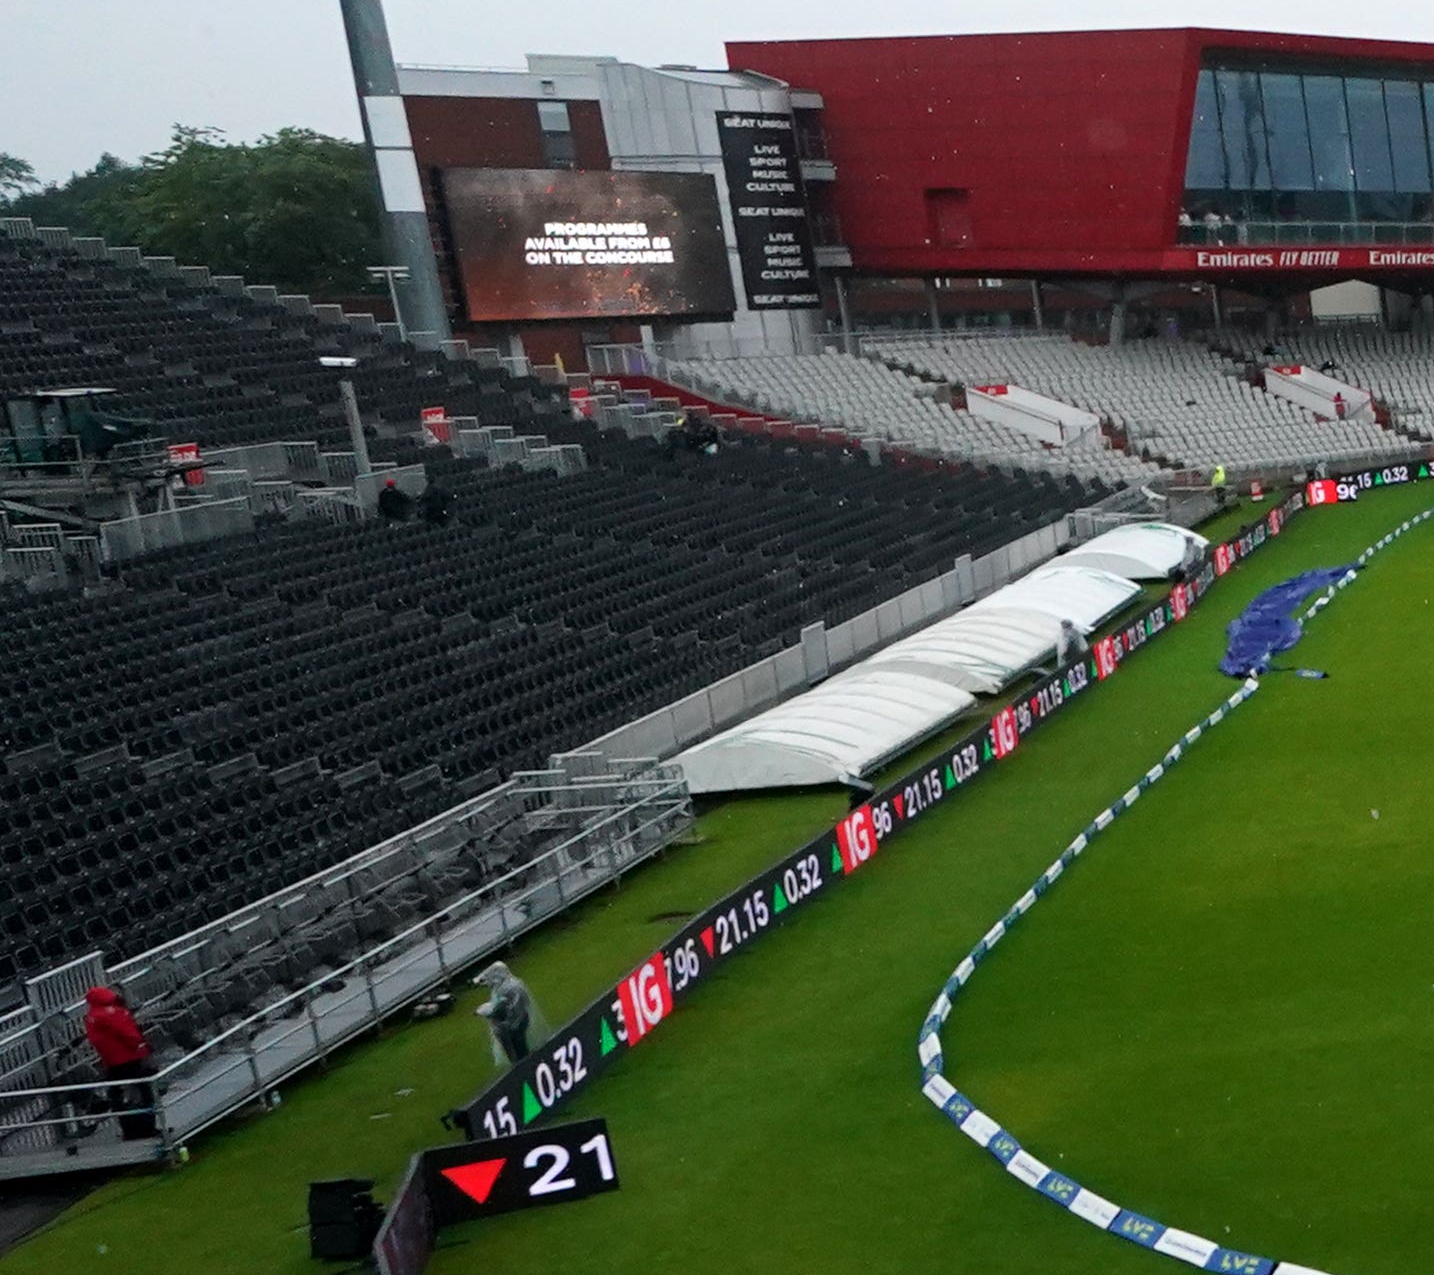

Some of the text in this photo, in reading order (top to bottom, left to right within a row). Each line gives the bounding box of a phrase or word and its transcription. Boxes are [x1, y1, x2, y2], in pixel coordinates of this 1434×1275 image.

[754, 145, 780, 154] LIVE
[544, 223, 647, 235] PROGRAMMES
[768, 233, 794, 242] LIVE
[525, 237, 606, 250] AVAILABLE
[608, 237, 650, 249] FROM
[525, 251, 674, 264] ON THE CONCOURSE
[1197, 250, 1339, 267] Emirates FLY BETTER
[998, 661, 1088, 754] IG 21.15 0.32
[844, 744, 980, 867] IG 96 21.15 0.32
[628, 962, 664, 1035] IG
[715, 889, 770, 955] 21.15
[784, 854, 824, 905] 0.32
[484, 1037, 588, 1140] 15 0.32
[522, 1132, 615, 1197] 21
